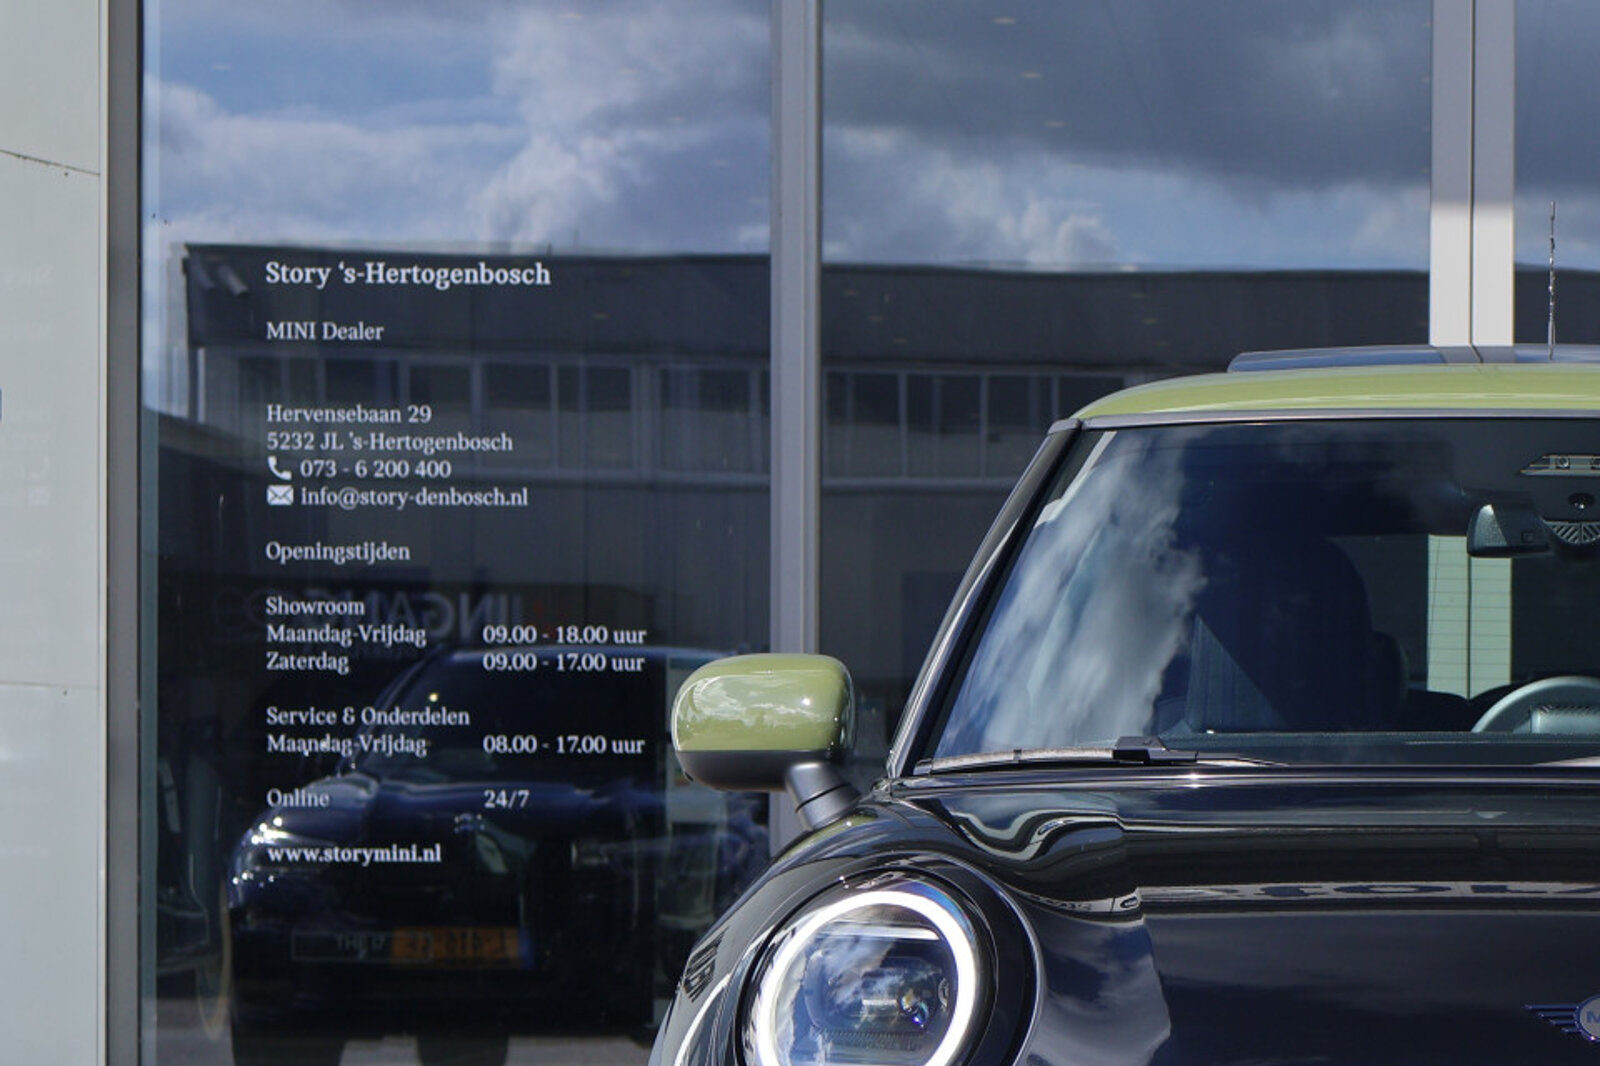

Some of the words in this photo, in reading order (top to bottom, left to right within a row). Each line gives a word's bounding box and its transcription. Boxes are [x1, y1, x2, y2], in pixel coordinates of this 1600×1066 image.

[266, 261, 331, 290] Story
[266, 321, 317, 342] MINI
[321, 321, 385, 342] Dealer
[266, 404, 402, 424] Hervensebaan
[407, 404, 433, 424] 29
[267, 431, 315, 452] 5232
[320, 431, 344, 452] JL
[300, 459, 338, 479] 073
[354, 459, 368, 479] 6
[372, 459, 411, 479] 200
[415, 459, 453, 479] 400
[301, 486, 529, 511] info@story-denbosch.nl
[266, 542, 411, 567] Openingstijden
[266, 595, 366, 617] Showroom
[266, 623, 427, 649] Maandag-Vrijdag
[482, 624, 538, 646] 09.00
[556, 625, 608, 645] 18.00
[612, 631, 648, 646] uur
[266, 651, 351, 677] Zaterdag
[482, 652, 538, 673] 09.00
[556, 652, 608, 672] 17.00
[612, 658, 646, 673] uur
[266, 706, 338, 727] Service
[342, 706, 356, 726] &
[360, 706, 470, 727] Onderdelen
[266, 733, 428, 759] Maandag-Vrijdag
[482, 734, 538, 755] 08.00
[556, 734, 608, 754] 17.00
[612, 740, 646, 755] uur
[266, 788, 330, 809] Online
[484, 788, 530, 810] 24/7
[267, 842, 442, 866] www.storymini.nl
